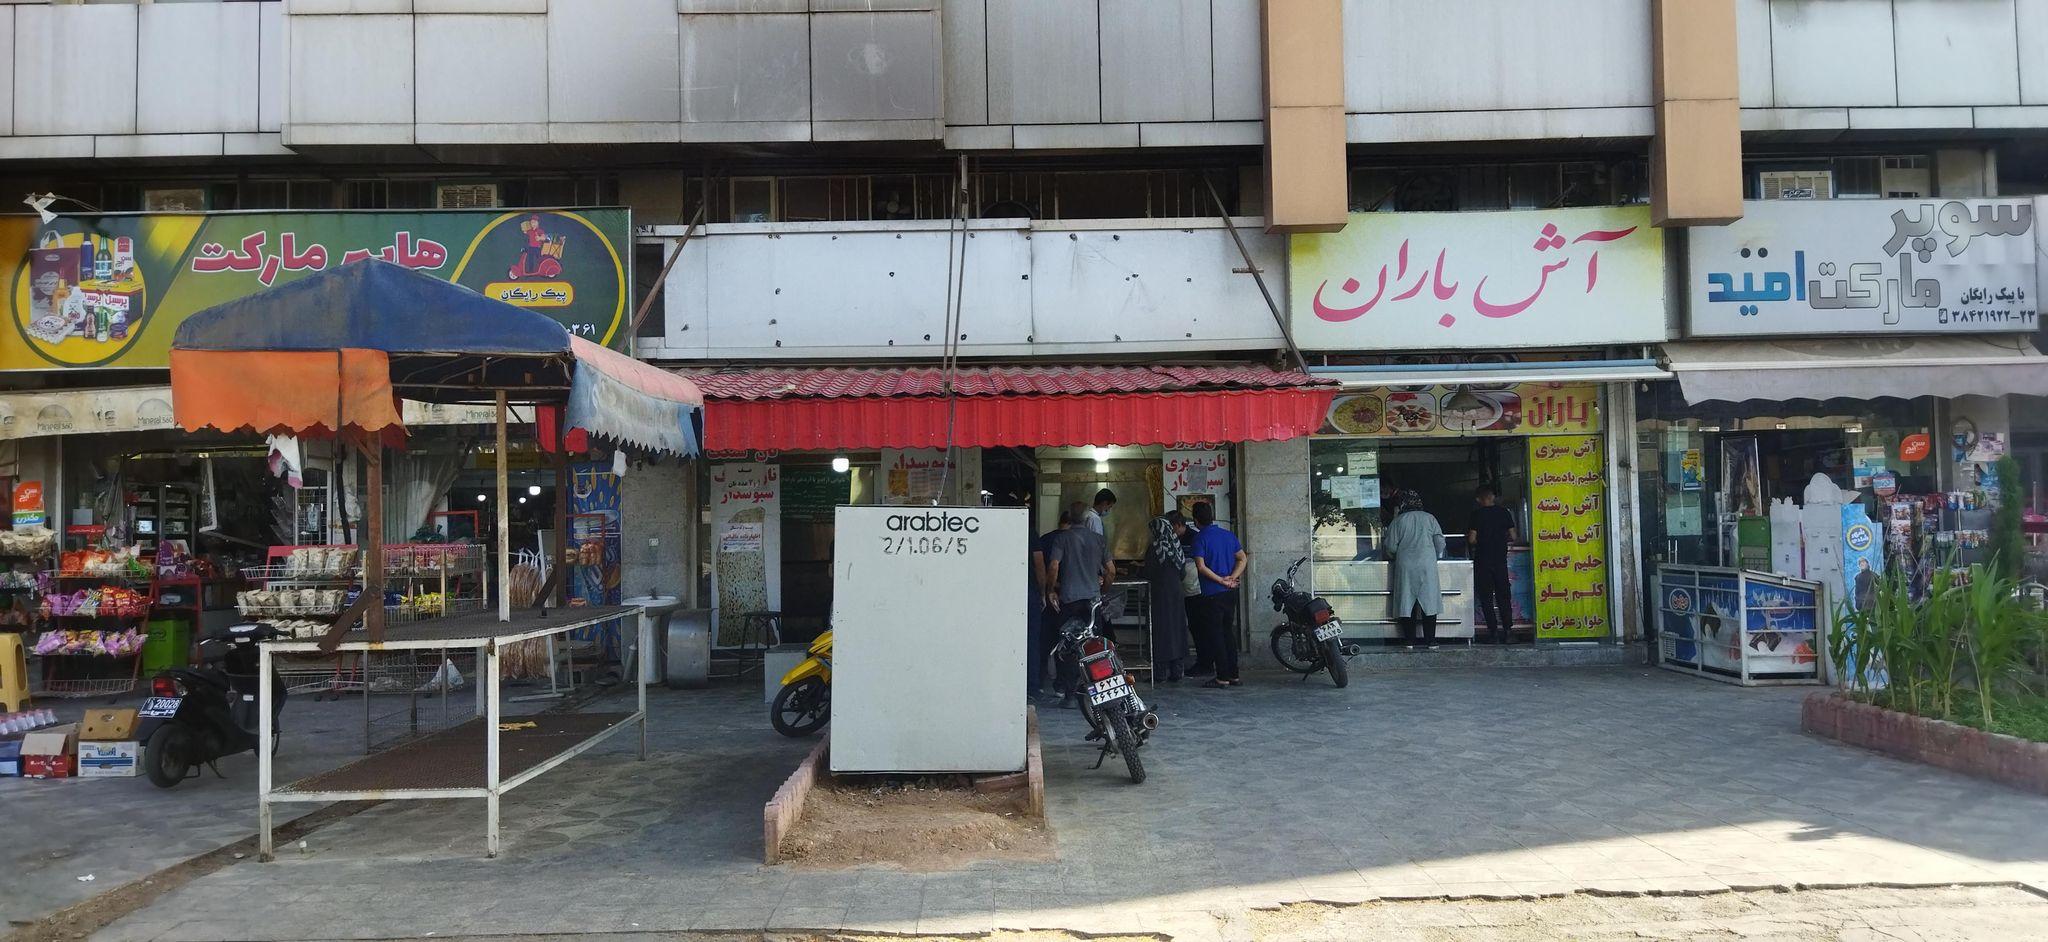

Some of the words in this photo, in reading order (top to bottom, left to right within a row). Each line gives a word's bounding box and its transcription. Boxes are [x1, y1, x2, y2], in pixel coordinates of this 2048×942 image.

[1882, 201, 2031, 263] سوپر
[191, 231, 328, 287] مارکت
[1473, 222, 1638, 318] آش
[1312, 238, 1459, 328] باران
[1808, 253, 1940, 325] مارکت
[501, 288, 538, 303] رایگان
[541, 288, 566, 304] پیک
[1960, 287, 1993, 304] رایگان
[1995, 287, 2014, 304] پیک
[2017, 287, 2025, 304] با
[1528, 395, 1589, 428] باران
[1535, 443, 1570, 459] سبزی
[1573, 438, 1598, 457] آش
[1207, 453, 1226, 472] نان
[1534, 471, 1575, 487] بادمجان
[1577, 471, 1600, 487] حلیم
[1537, 497, 1569, 515] رشته
[1573, 494, 1600, 515] آش
[886, 511, 980, 533] arabtec
[1538, 526, 1573, 541] ماست
[1576, 524, 1601, 543] آش
[1539, 556, 1570, 571] گندم
[1574, 554, 1603, 572] حلیم
[1540, 583, 1568, 602] پلو
[1572, 583, 1604, 601] کلم
[1541, 616, 1583, 631] زعفرانی
